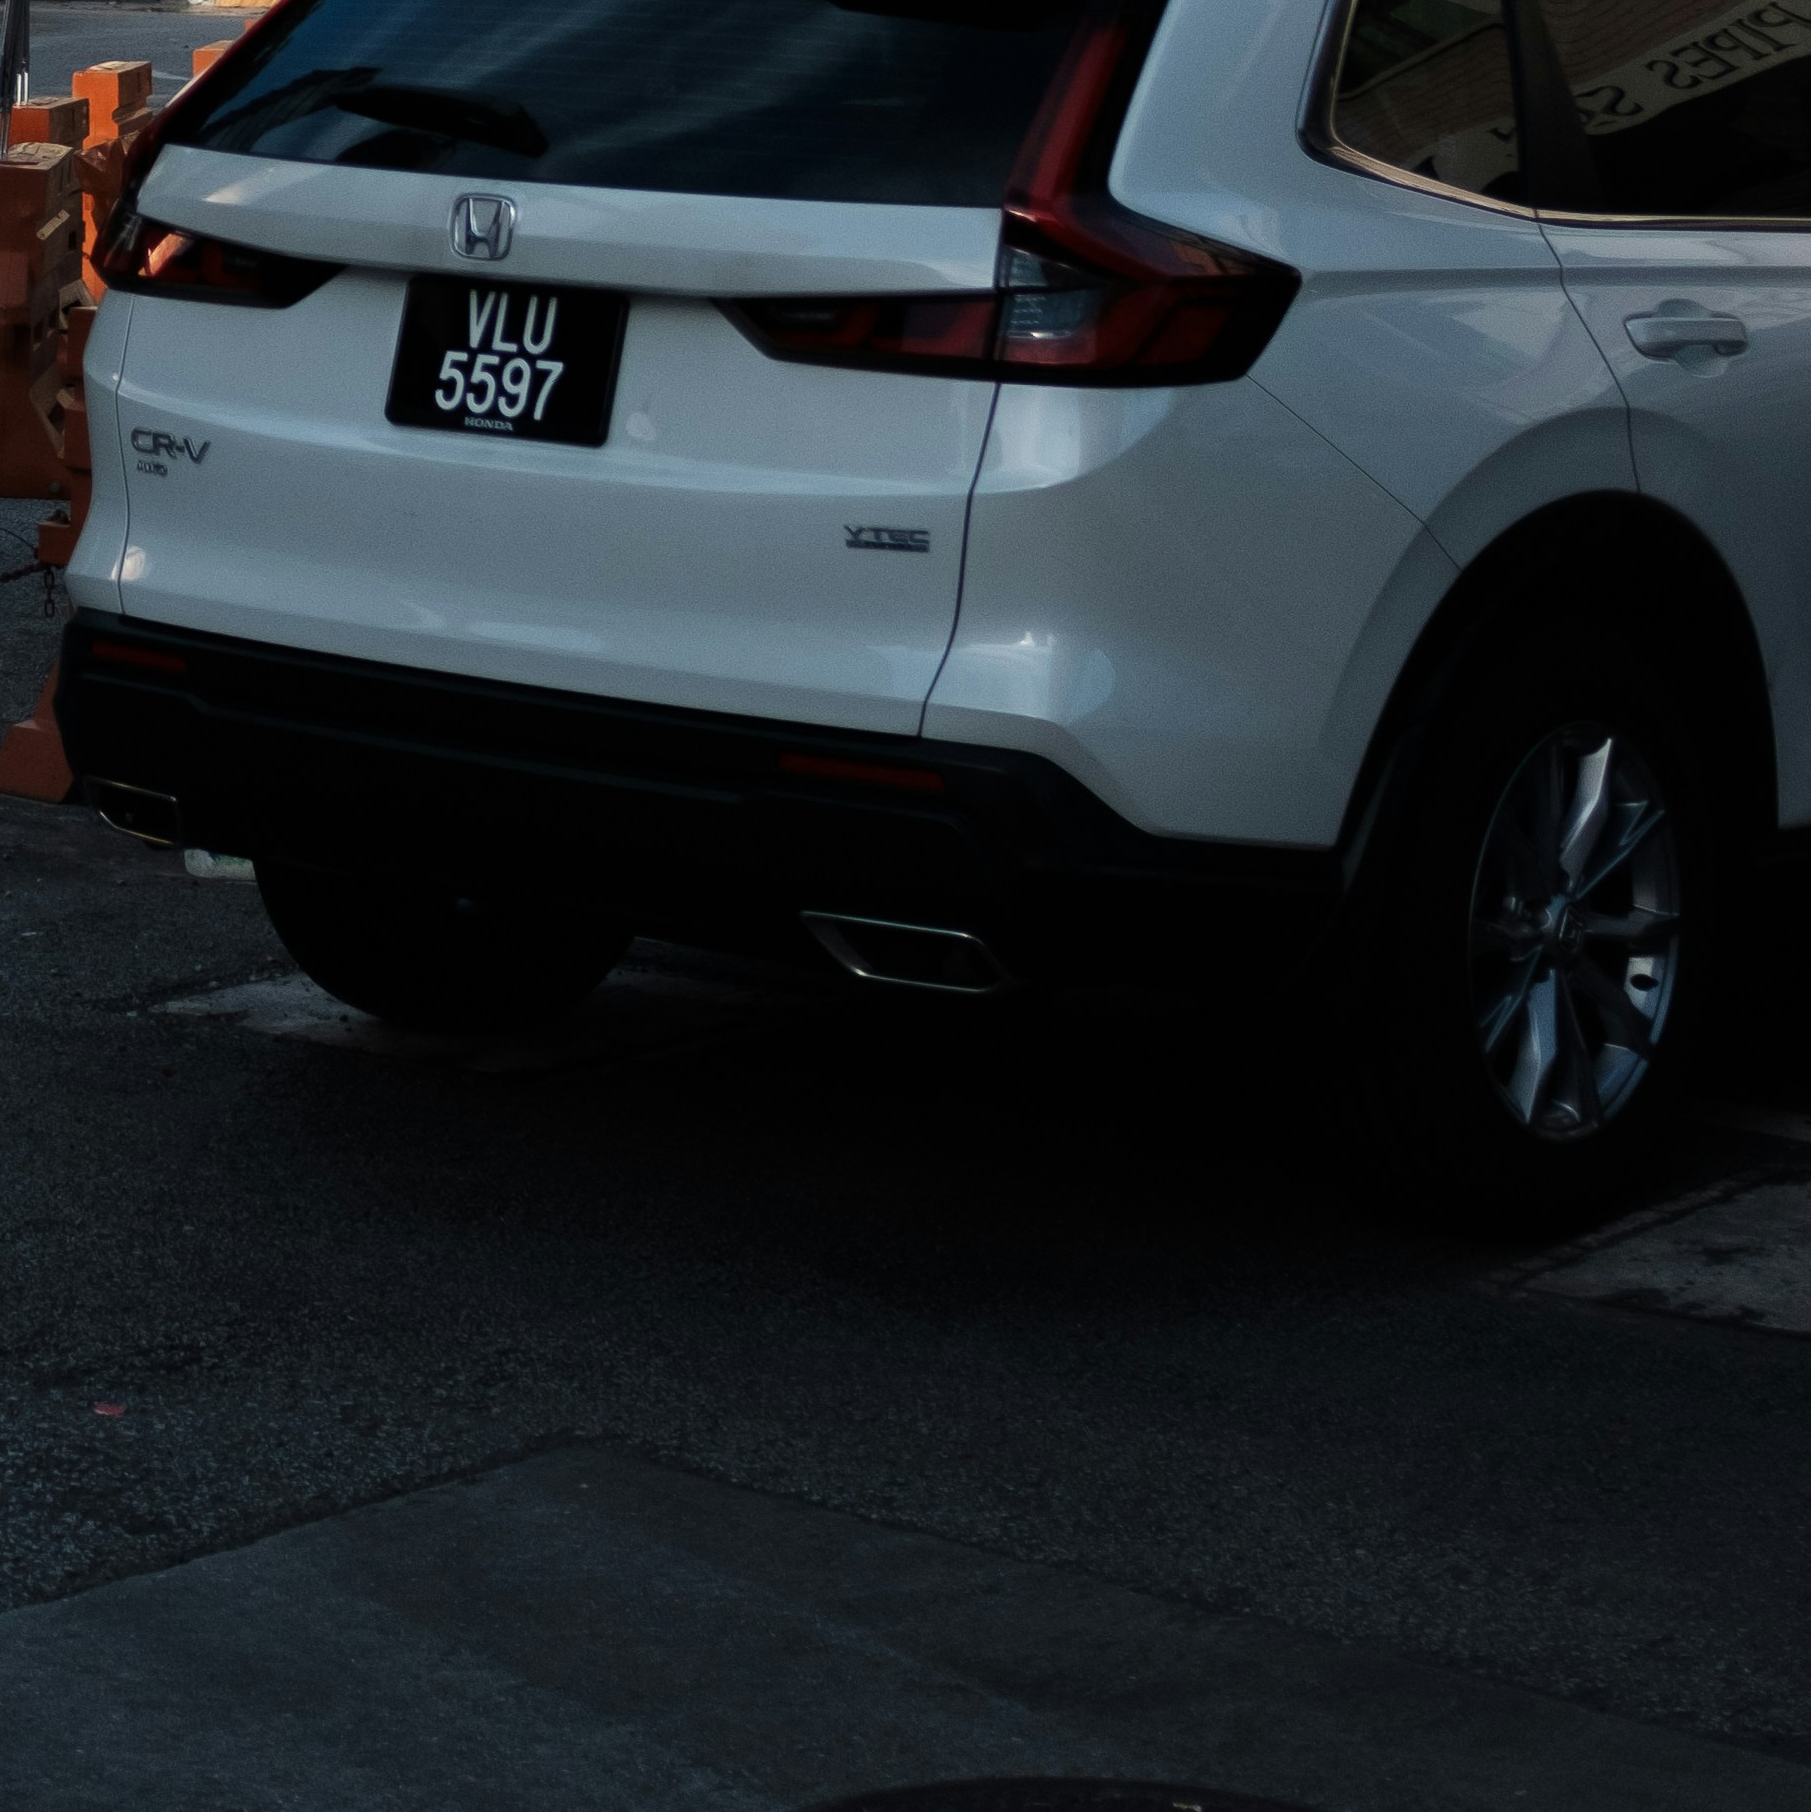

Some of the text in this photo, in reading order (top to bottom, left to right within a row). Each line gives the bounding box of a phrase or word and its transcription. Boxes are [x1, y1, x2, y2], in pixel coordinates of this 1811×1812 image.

[469, 288, 558, 355] VLU
[434, 349, 564, 421] 5597
[464, 416, 514, 432] HONDA
[130, 427, 211, 464] CR-V
[843, 524, 930, 545] VTEC
